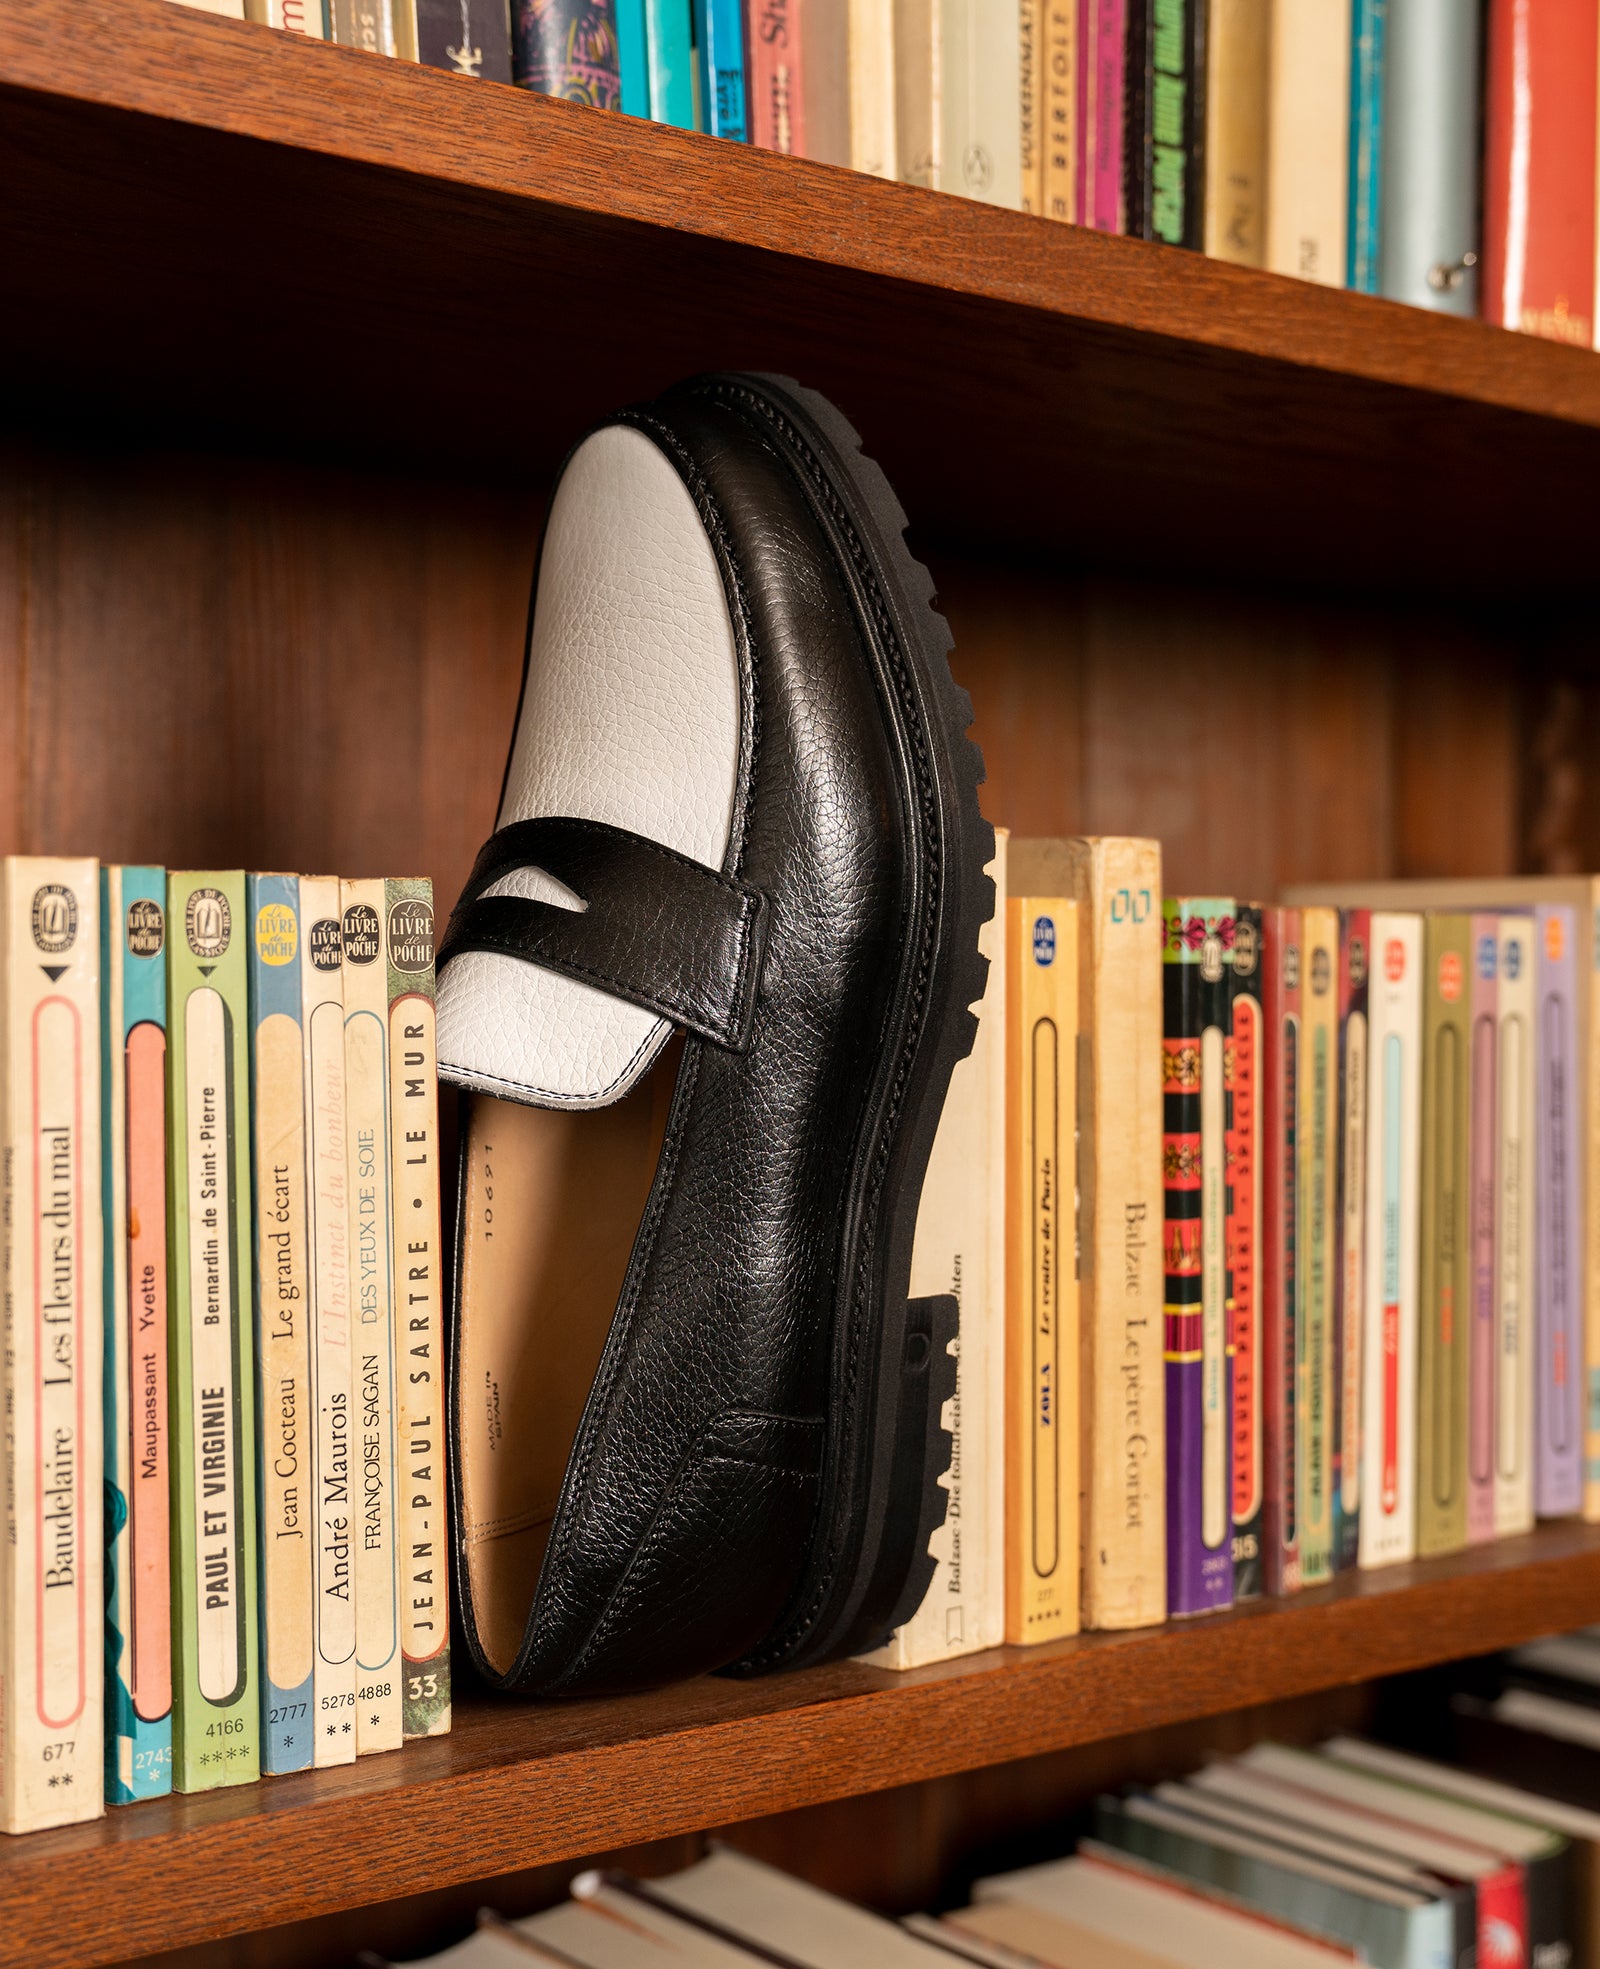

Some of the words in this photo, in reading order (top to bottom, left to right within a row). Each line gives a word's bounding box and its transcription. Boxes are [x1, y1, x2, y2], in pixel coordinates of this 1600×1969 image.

[259, 919, 295, 934] LIVRE
[344, 918, 378, 933] LIVRE
[351, 905, 369, 918] Le
[354, 932, 369, 941] de
[392, 918, 434, 935] LIVRE
[401, 902, 420, 917] Le
[260, 942, 293, 957] POCHE
[345, 941, 377, 956] POCHE
[393, 945, 433, 962] POCHE
[404, 935, 421, 945] de
[404, 1024, 426, 1098] MUR
[320, 1059, 344, 1162] bonheur
[1237, 1015, 1250, 1175] SPECTACLE
[42, 1126, 72, 1181] mal
[202, 1087, 217, 1199] Saint-Pierre
[359, 1128, 374, 1178] SOIE
[407, 1130, 427, 1165] LE
[42, 1190, 72, 1229] du
[268, 1164, 290, 1223] écart
[322, 1174, 345, 1209] du
[360, 1186, 376, 1214] DE
[484, 1145, 494, 1242] 10691
[1040, 1158, 1050, 1212] Paris
[203, 1208, 218, 1228] de
[1041, 1218, 1050, 1240] de
[268, 1231, 300, 1301] grand
[360, 1220, 376, 1281] YEUX
[1125, 1200, 1148, 1298] Balzac
[42, 1236, 73, 1325] fleurs
[141, 1265, 156, 1331] Yvette
[204, 1239, 220, 1326] Bernardin
[324, 1222, 348, 1348] L'Instinct
[362, 1284, 377, 1325] DES
[272, 1309, 294, 1341] Le
[409, 1241, 431, 1384] SARTRE
[1040, 1311, 1050, 1336] Le
[44, 1333, 73, 1387] Les
[1125, 1318, 1148, 1363] Le
[142, 1353, 160, 1480] Maupassant
[364, 1354, 379, 1428] SAGAN
[492, 1383, 503, 1439] SPAIN
[1041, 1363, 1050, 1427] ZOLA
[1120, 1364, 1145, 1426] père
[202, 1386, 227, 1498] VIRGINIE
[276, 1378, 298, 1479] Cocteau
[323, 1392, 348, 1506] Maurois
[486, 1396, 496, 1451] MADE
[1236, 1373, 1248, 1501] JACQUES
[44, 1427, 75, 1591] Baudelaire
[364, 1433, 383, 1551] FRANÇOISE
[1125, 1434, 1150, 1530] Goriot
[204, 1510, 227, 1537] ET
[278, 1487, 304, 1541] Jean
[412, 1415, 434, 1631] JEAN-PAUL
[206, 1547, 229, 1610] PAUL
[324, 1516, 349, 1602] André
[269, 1703, 307, 1724] 2777
[321, 1693, 355, 1710] 5278
[358, 1683, 392, 1700] 4888
[408, 1674, 438, 1700] 33
[43, 1741, 75, 1762] 677
[206, 1718, 244, 1738] 4166
[136, 1746, 172, 1769] 2743
